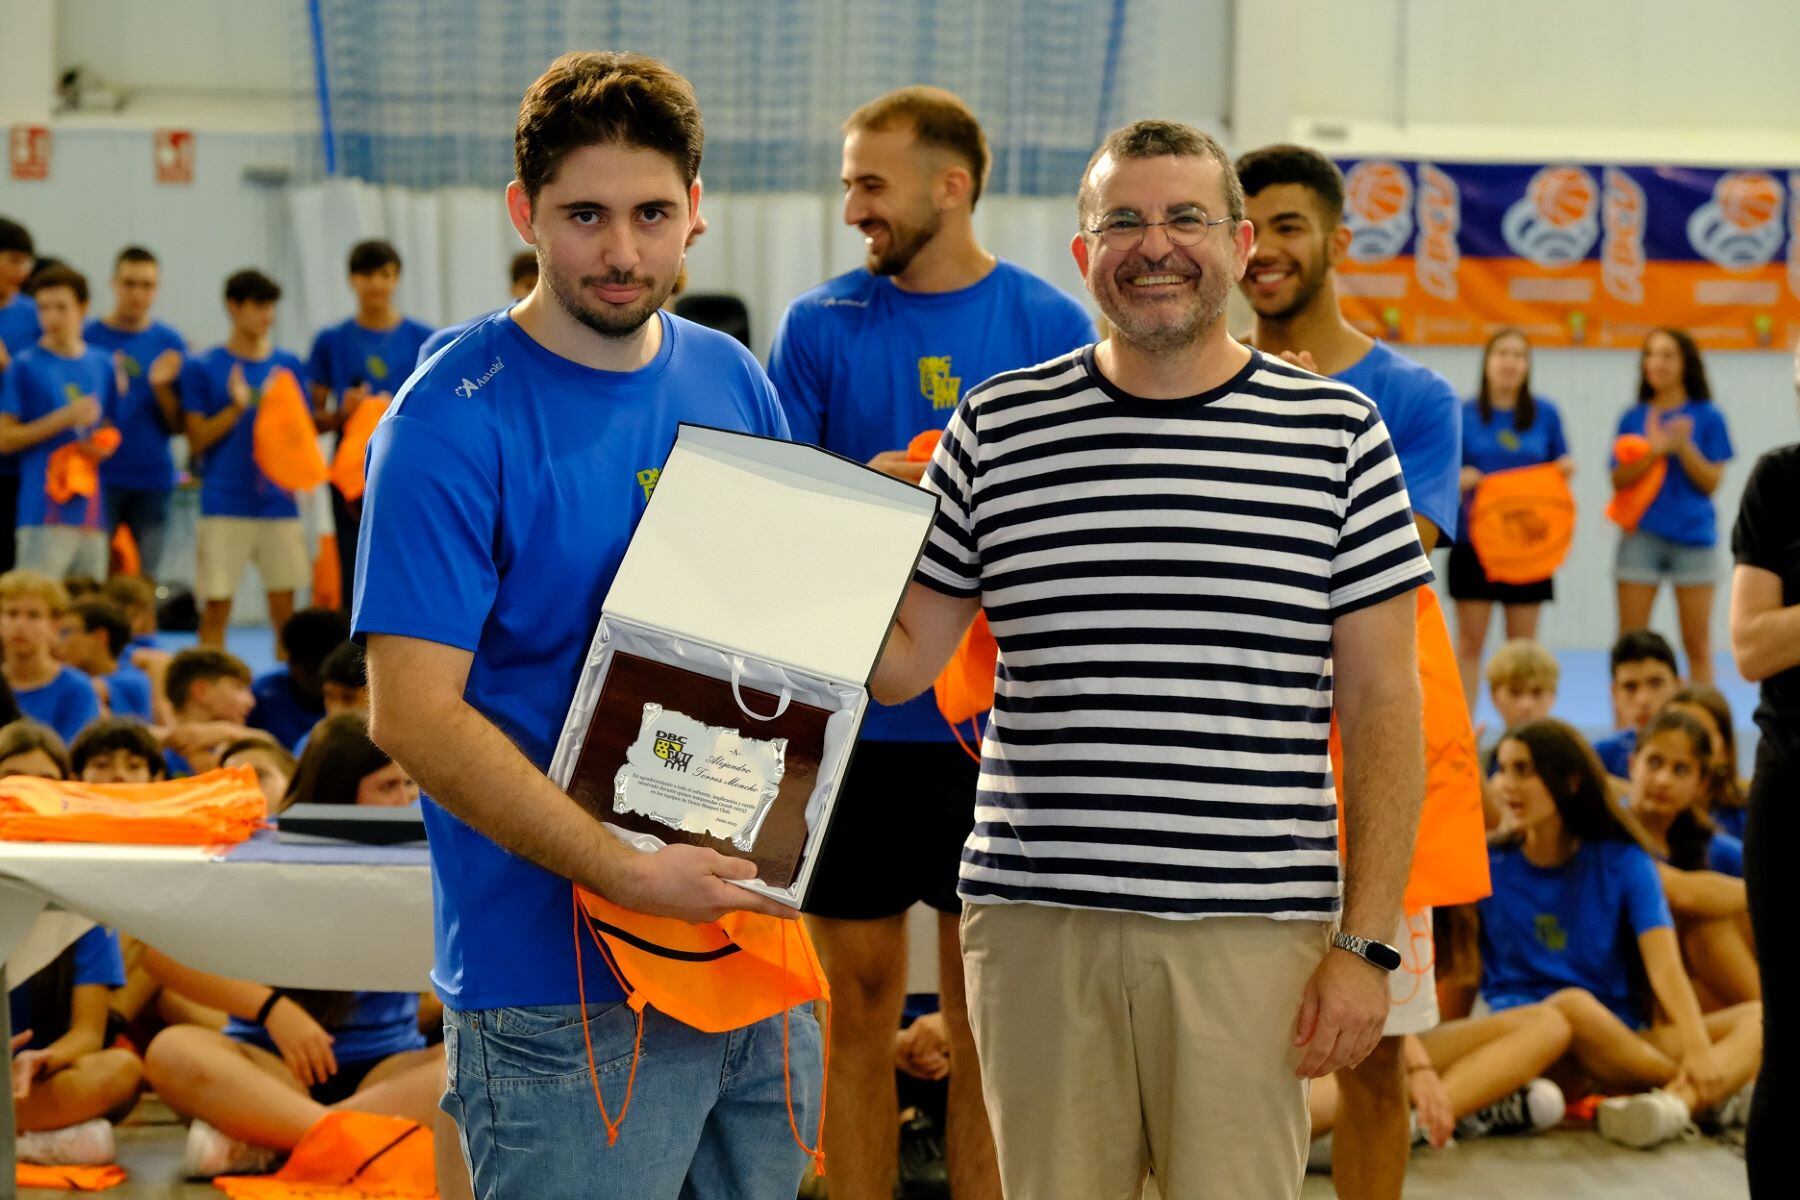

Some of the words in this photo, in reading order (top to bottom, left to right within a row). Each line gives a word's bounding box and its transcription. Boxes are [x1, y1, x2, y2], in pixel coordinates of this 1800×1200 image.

[655, 730, 688, 745] DBC
[705, 755, 752, 774] Alejandro
[692, 766, 723, 783] Torres
